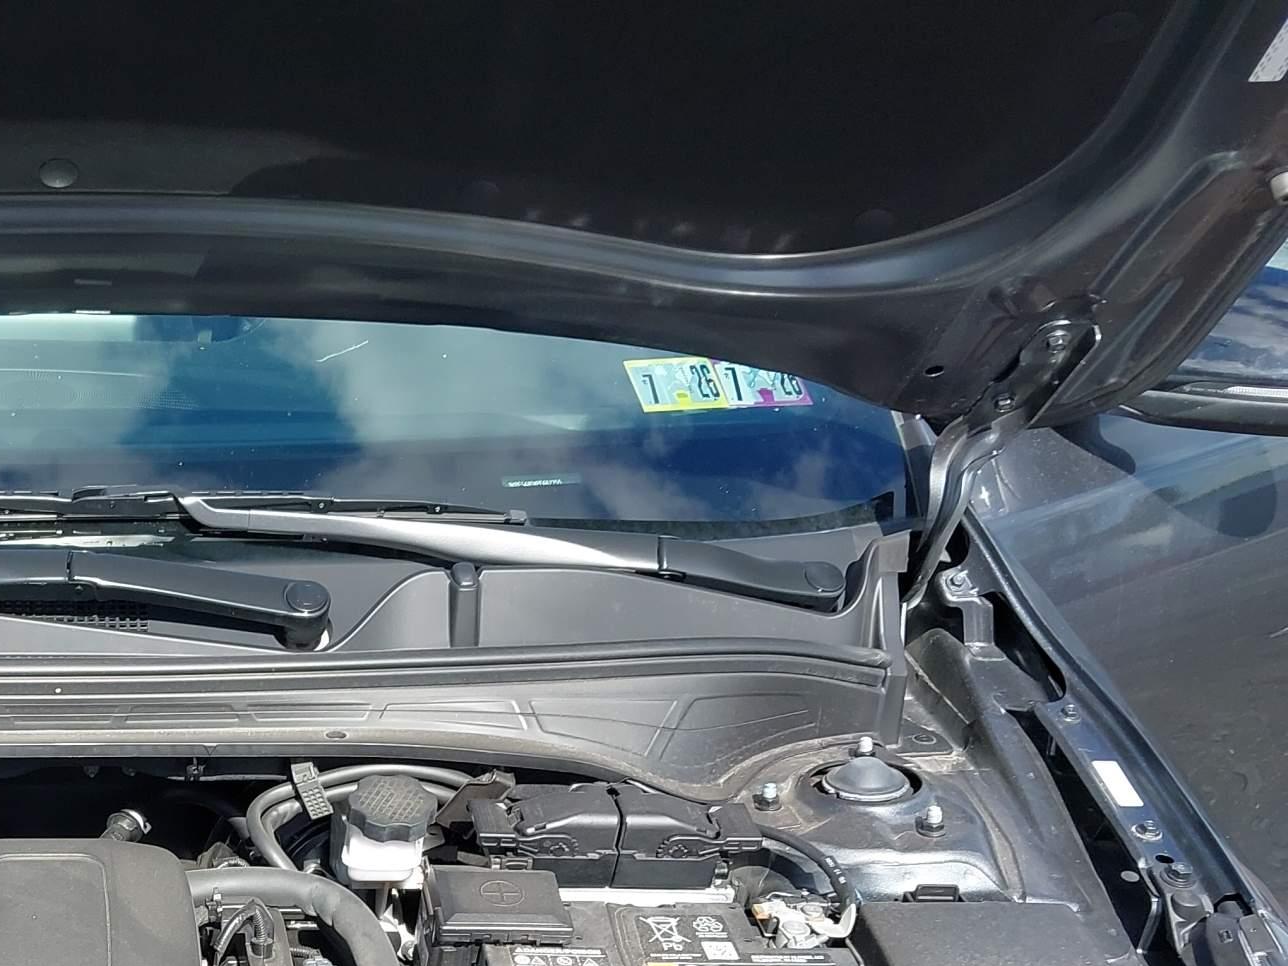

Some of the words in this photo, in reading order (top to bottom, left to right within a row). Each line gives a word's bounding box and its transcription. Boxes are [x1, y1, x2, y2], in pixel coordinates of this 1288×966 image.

[642, 374, 659, 404] 7
[690, 364, 720, 398] 26
[725, 367, 743, 401] 7
[662, 942, 683, 951] Pb
